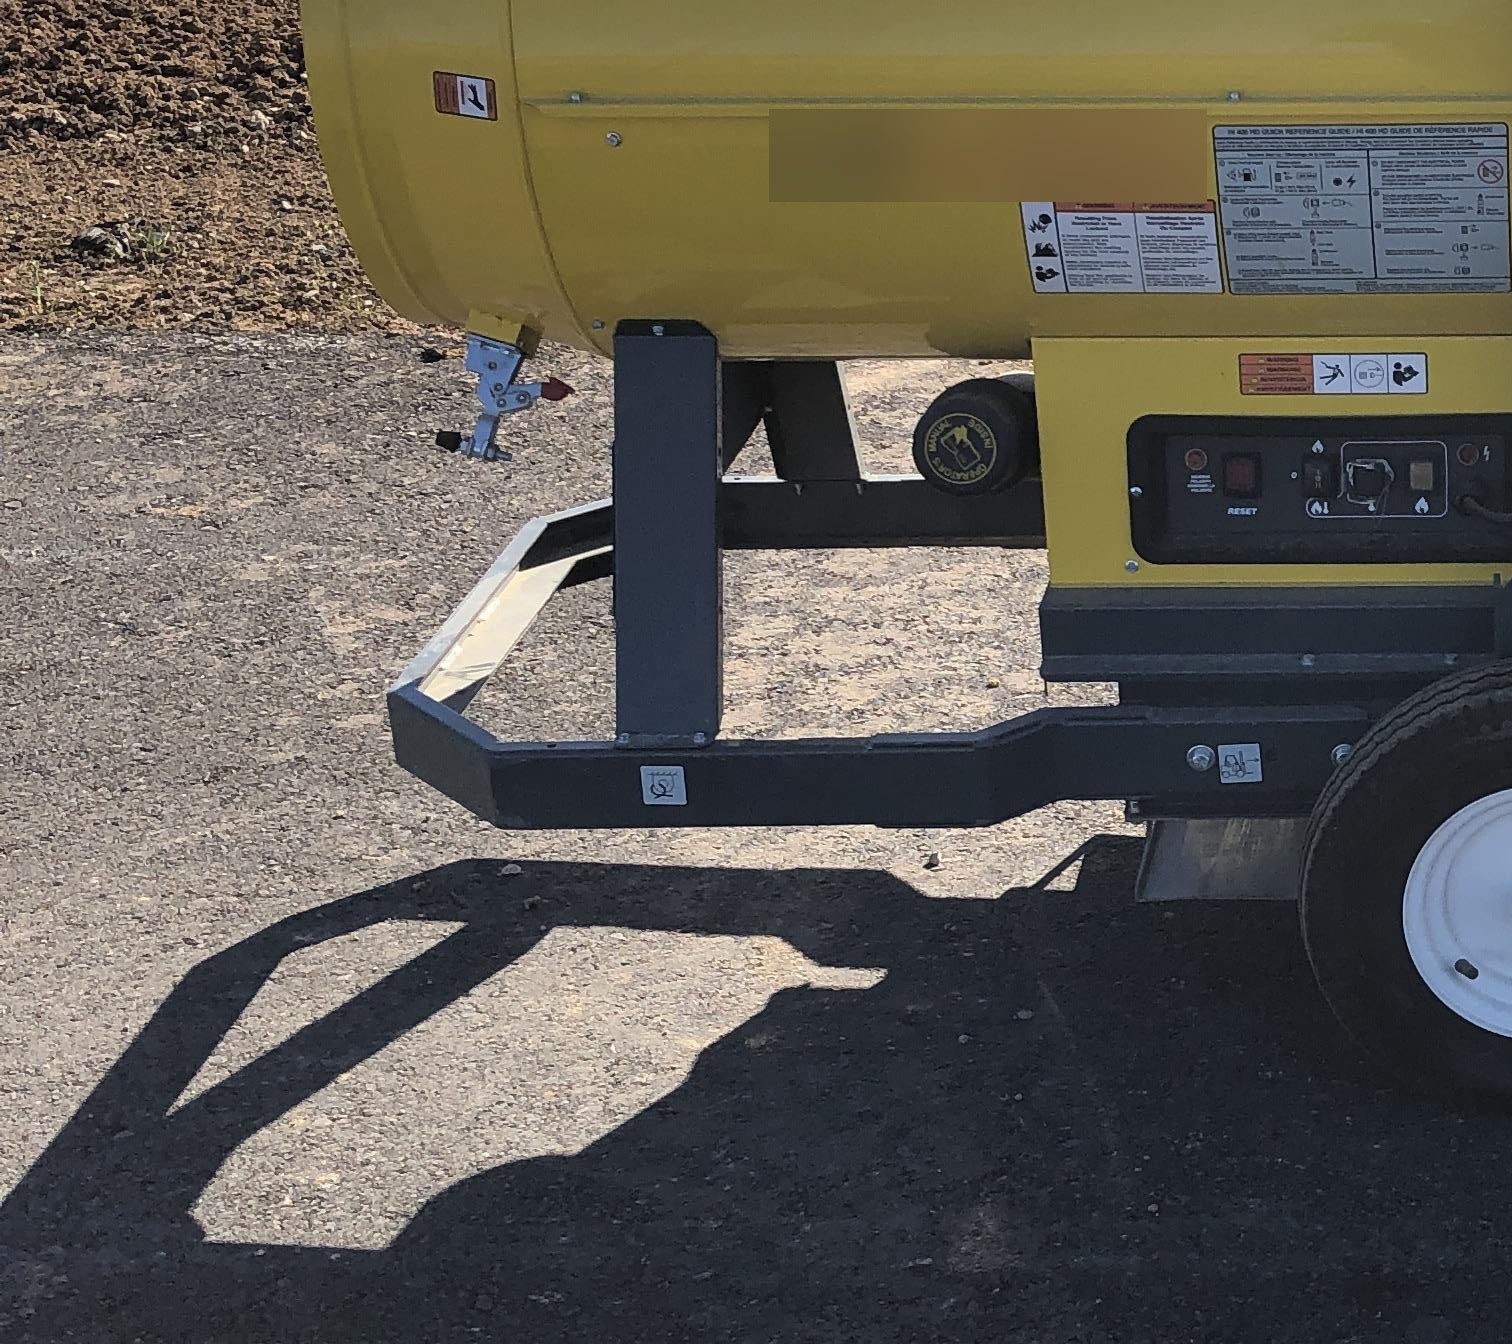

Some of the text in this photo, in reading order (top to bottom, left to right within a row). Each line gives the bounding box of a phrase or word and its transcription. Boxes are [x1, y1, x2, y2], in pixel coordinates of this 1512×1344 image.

[967, 418, 993, 449] INSIDE
[928, 419, 987, 481] OPERATORS MANUAL
[1227, 507, 1258, 515] RESET
